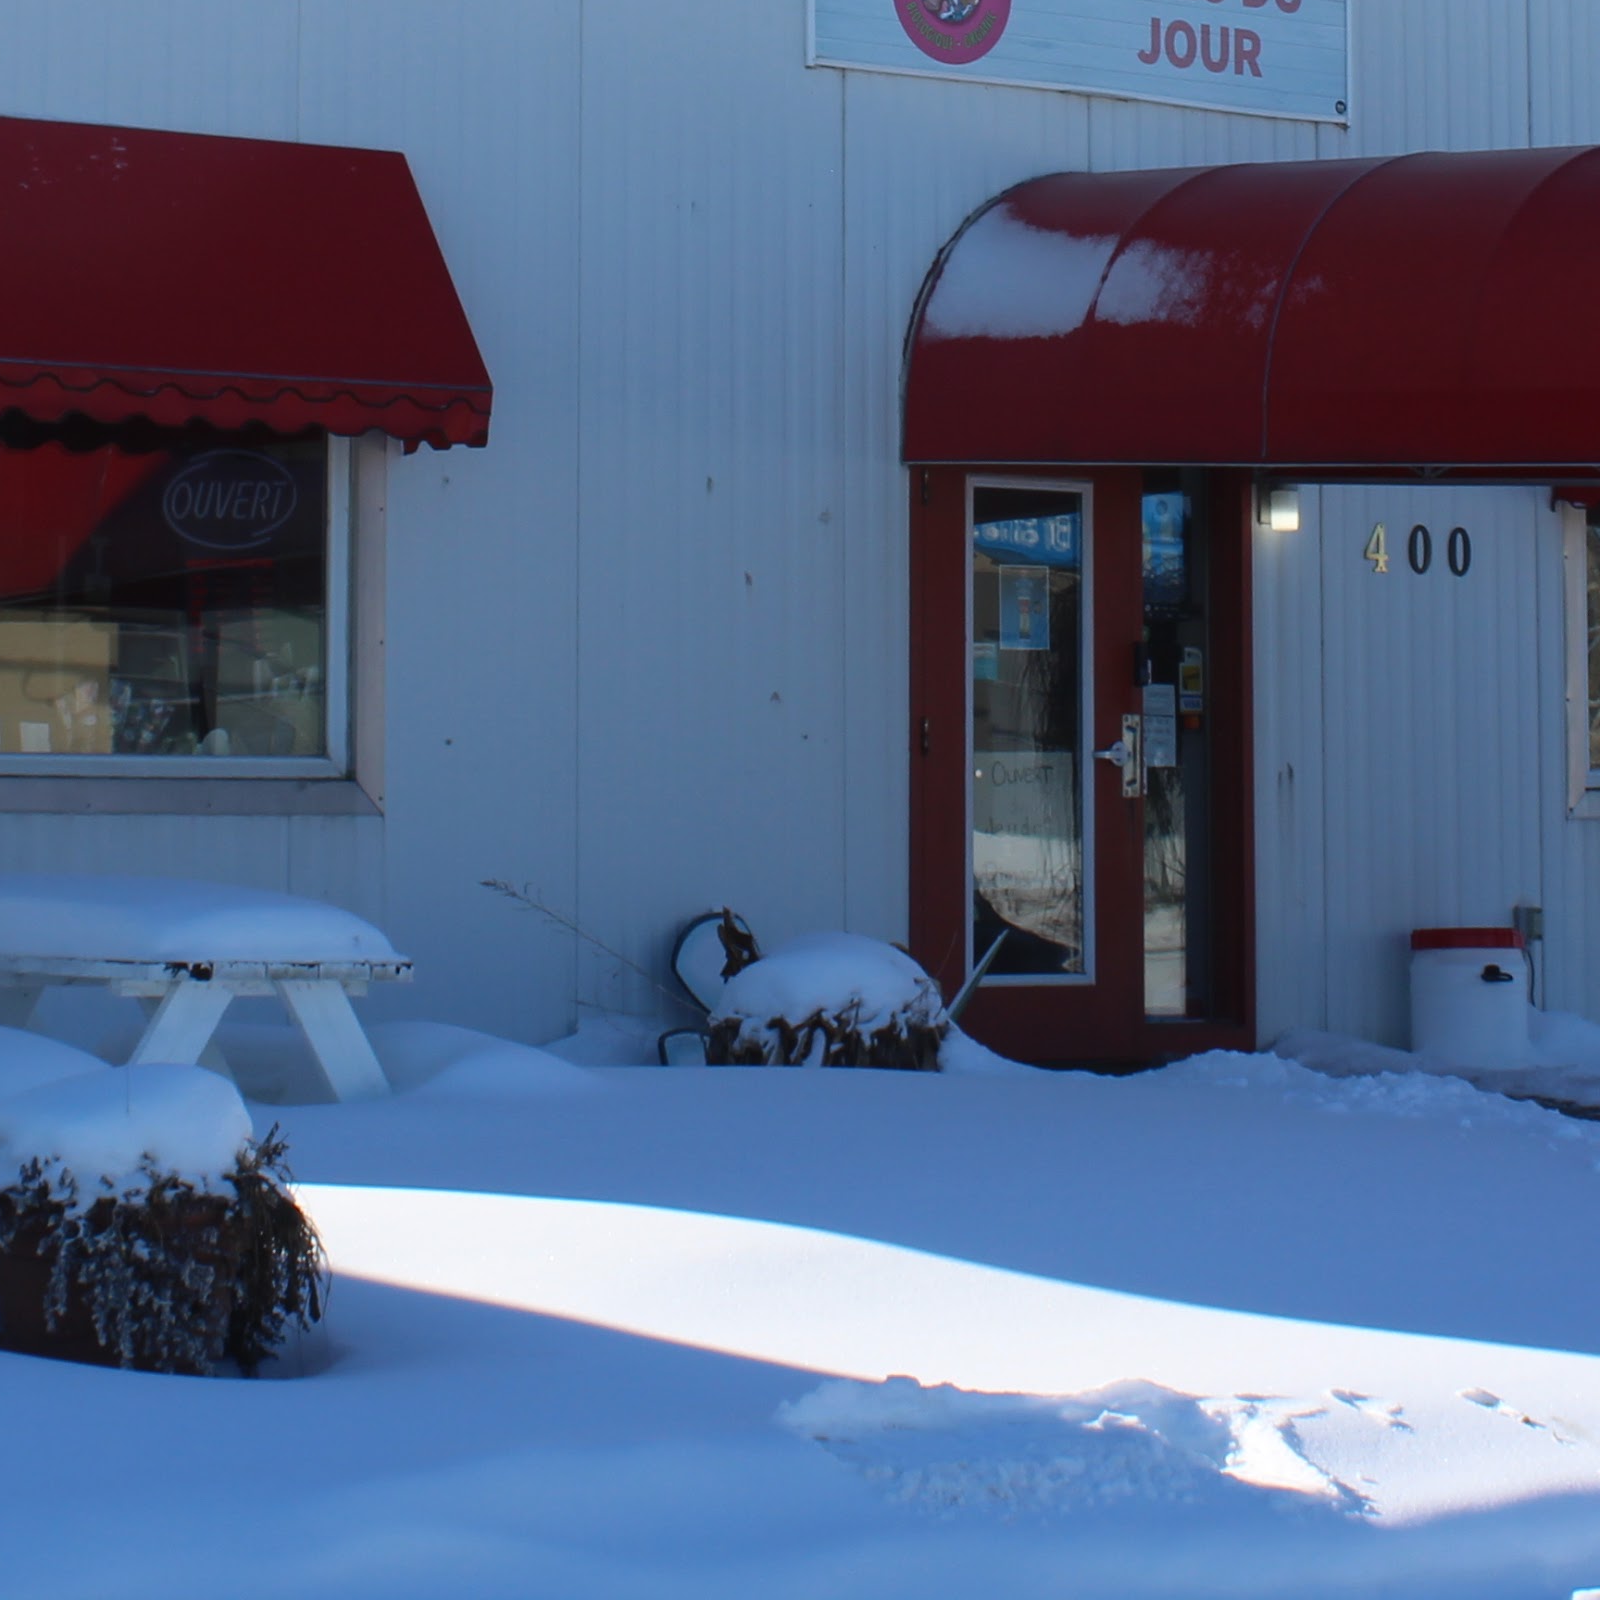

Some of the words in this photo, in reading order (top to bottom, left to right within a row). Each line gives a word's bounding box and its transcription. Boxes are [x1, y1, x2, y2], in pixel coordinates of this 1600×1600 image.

[1137, 17, 1262, 77] JOUR
[171, 480, 287, 520] OUVERT
[1363, 523, 1471, 576] 400
